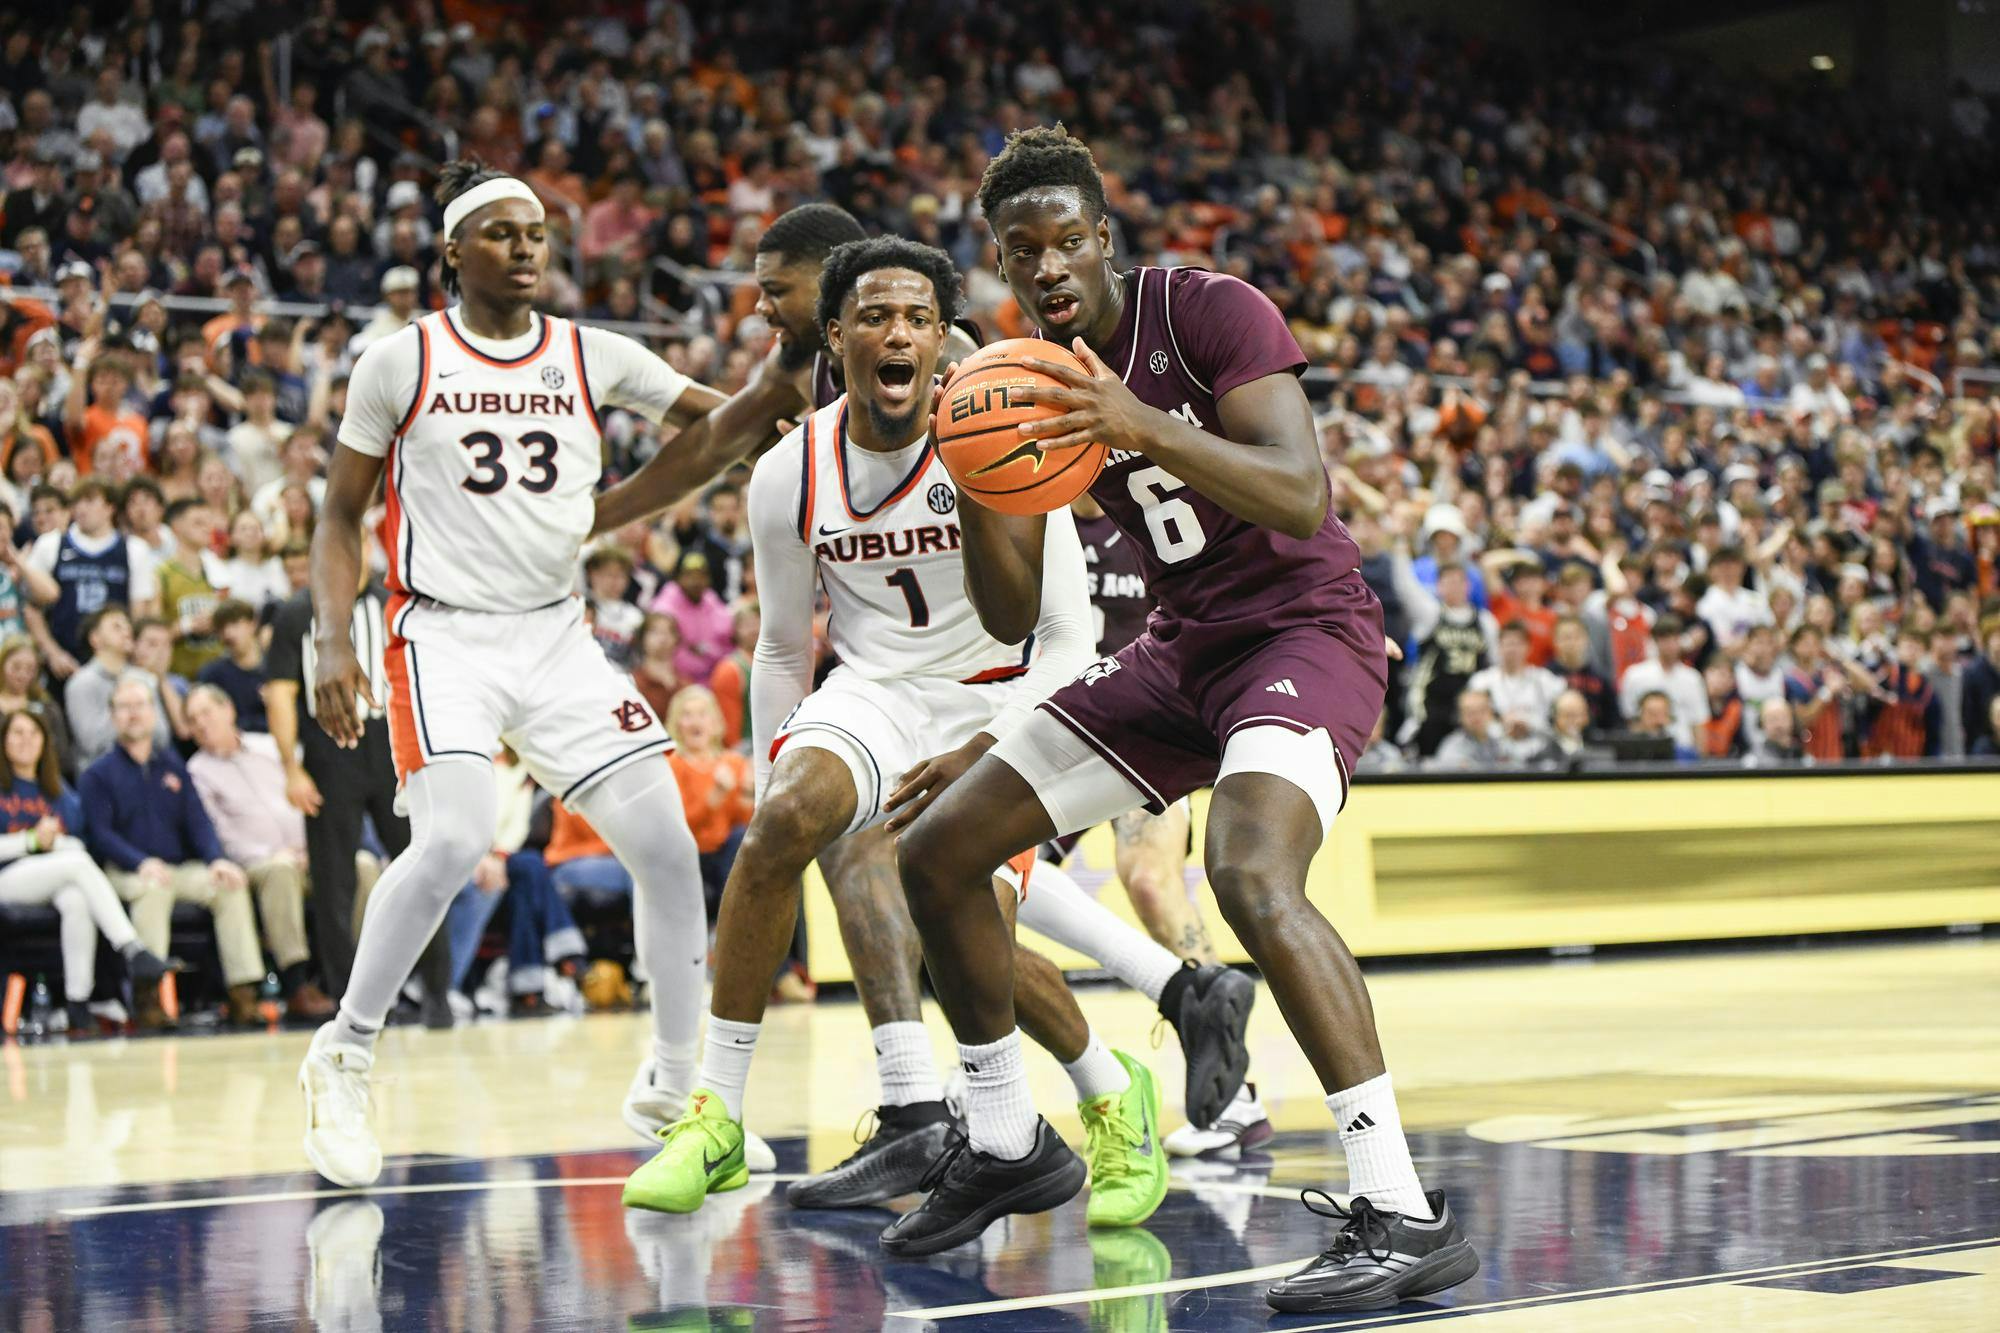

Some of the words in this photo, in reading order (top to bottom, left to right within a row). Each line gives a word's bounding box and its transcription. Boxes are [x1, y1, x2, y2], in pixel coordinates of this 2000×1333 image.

[1150, 351, 1168, 374] SEC
[428, 393, 575, 416] AUBURN
[460, 430, 558, 495] 33
[927, 483, 955, 514] SEC
[1127, 465, 1206, 564] 6
[814, 524, 962, 562] AUBURN
[885, 568, 930, 628] 1
